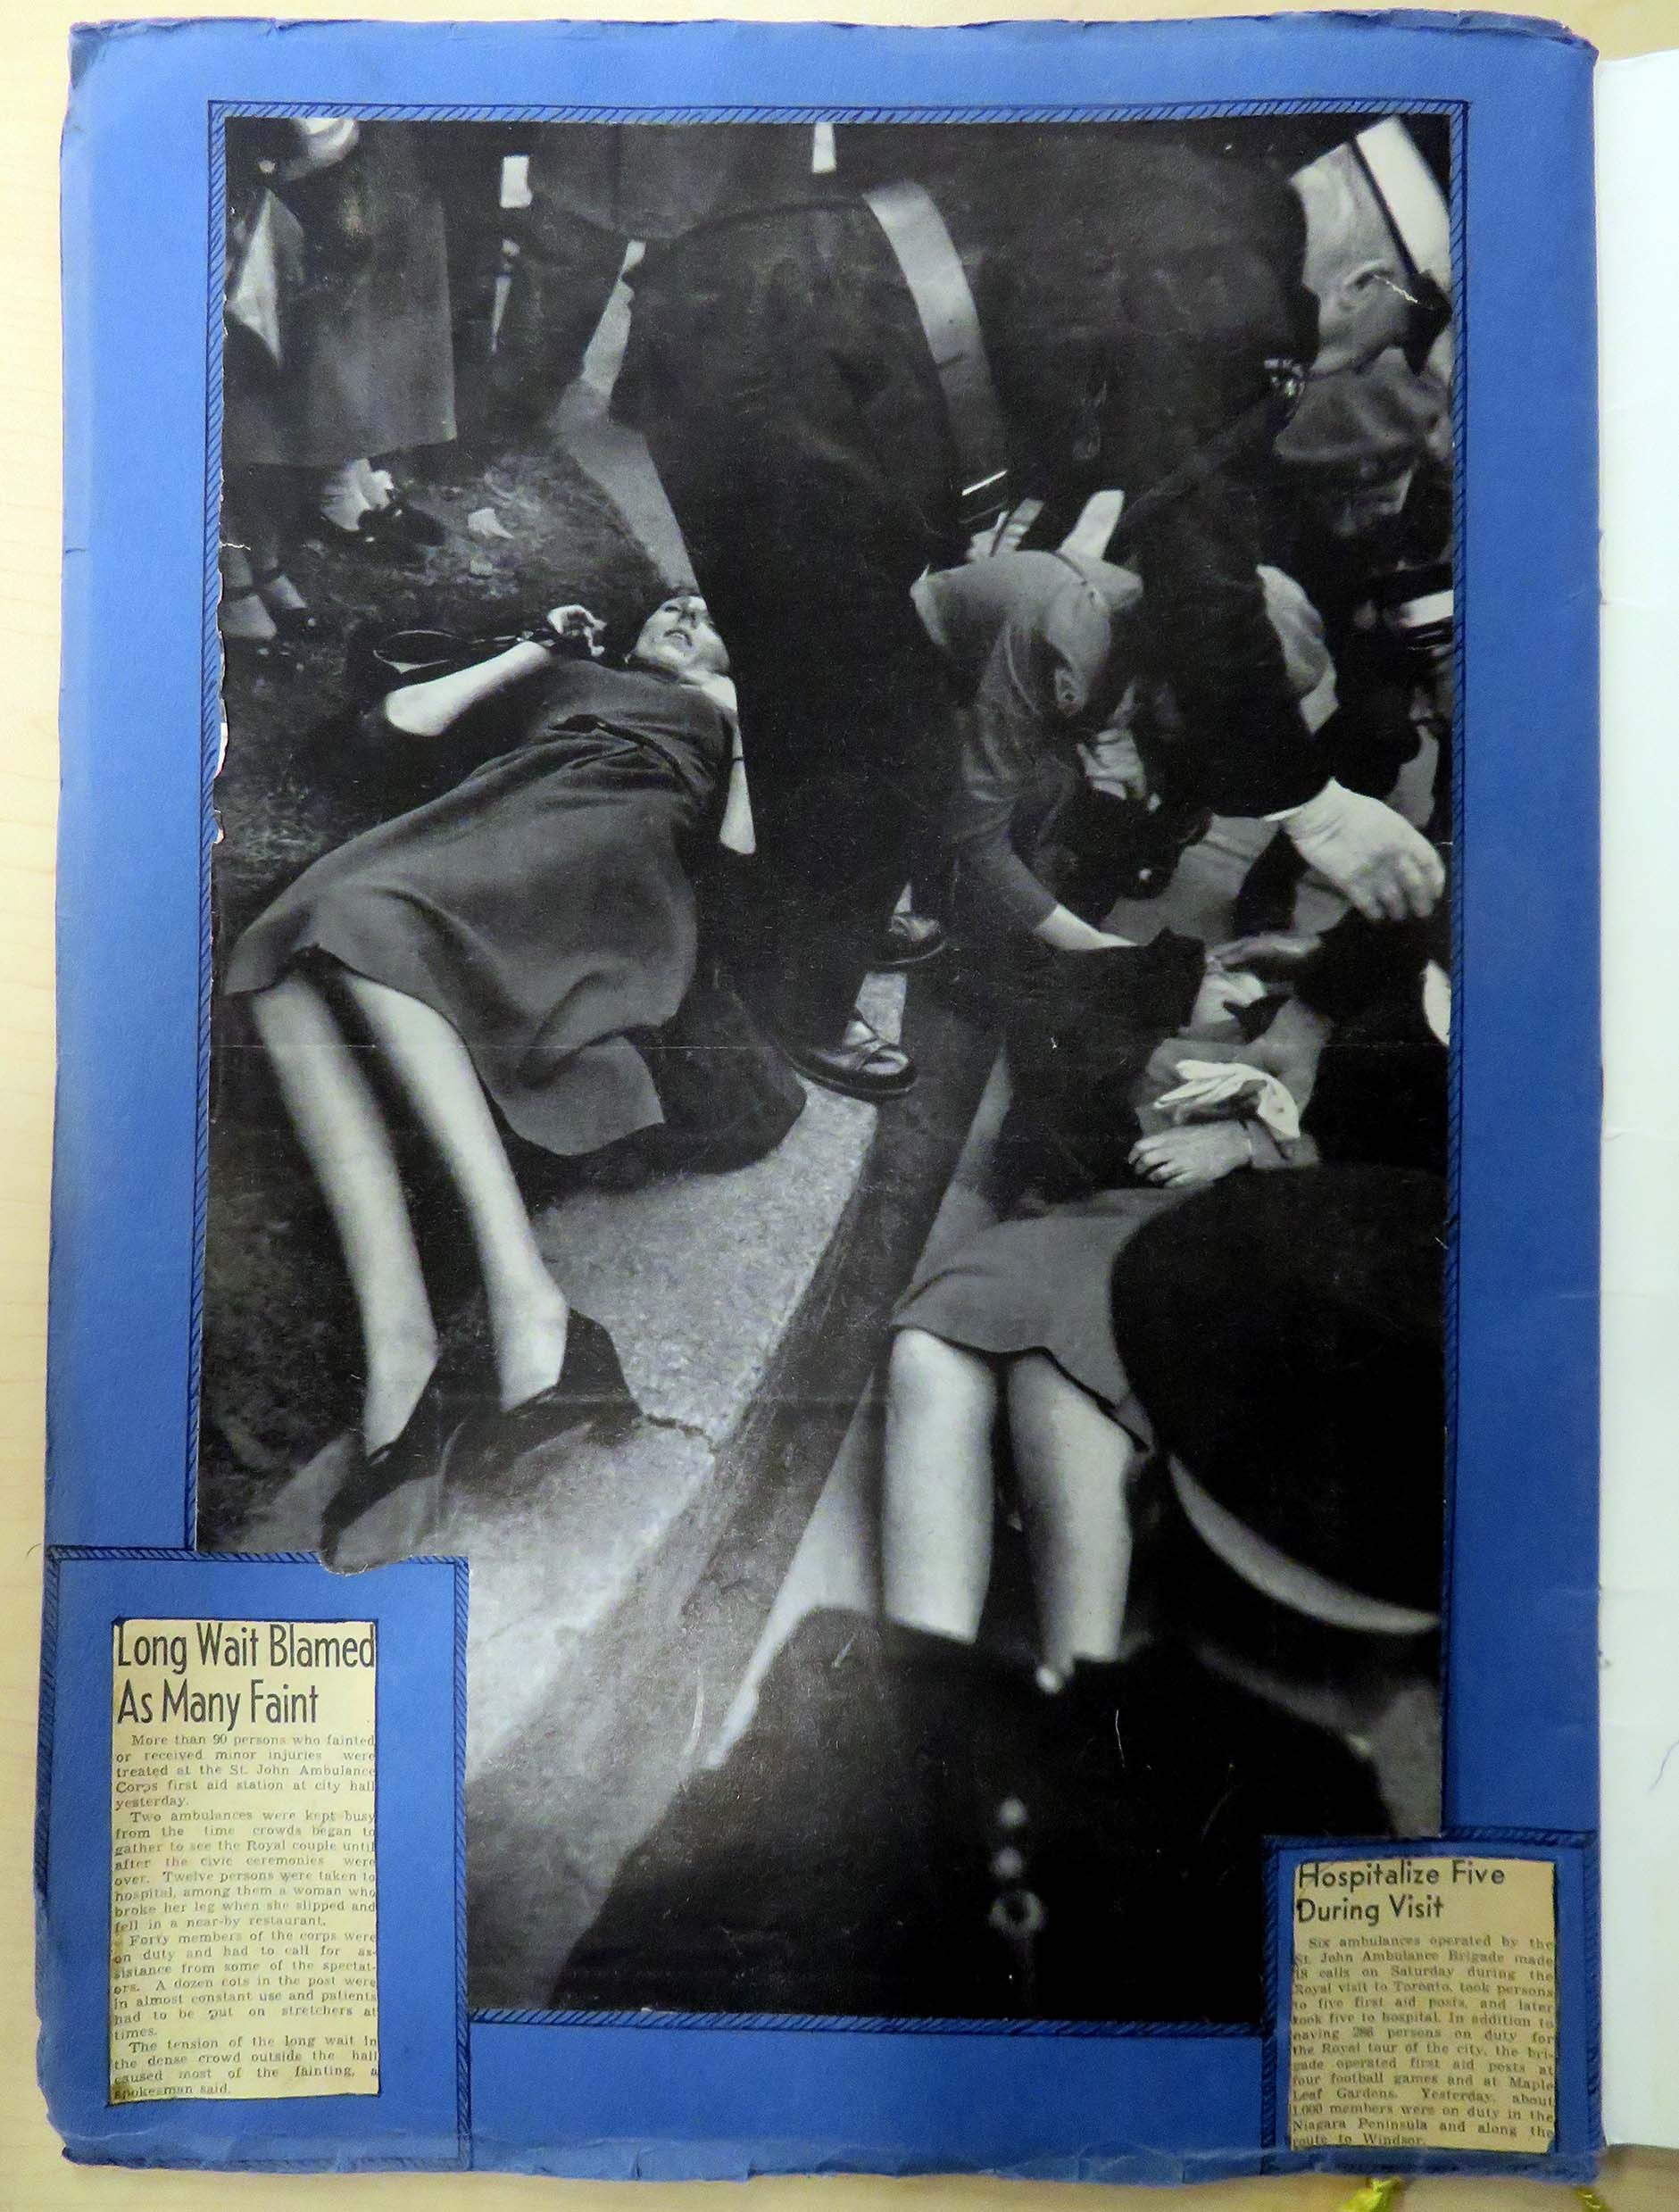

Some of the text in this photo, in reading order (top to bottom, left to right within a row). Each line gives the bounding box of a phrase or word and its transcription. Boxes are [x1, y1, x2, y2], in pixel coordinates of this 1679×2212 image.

[118, 1623, 374, 1675] Long Wait Blamed
[117, 1678, 319, 1731] As Many Faint
[175, 1734, 206, 1745] than
[213, 1734, 227, 1745] 90
[293, 1735, 320, 1746] who
[215, 1750, 256, 1759] minor
[200, 1766, 220, 1775] the
[257, 1765, 288, 1775] John
[168, 1780, 197, 1790] first
[207, 1780, 227, 1790] aid
[237, 1780, 284, 1790] station
[293, 1781, 307, 1790] at
[315, 1781, 340, 1793] city
[262, 1811, 295, 1821] were
[306, 1811, 335, 1823] kept
[162, 1826, 183, 1836] the
[312, 1826, 351, 1838] began
[219, 1841, 240, 1850] the
[247, 1841, 286, 1852] Royal
[293, 1841, 336, 1852] couple
[166, 1858, 187, 1867] the
[200, 1856, 233, 1866] civic
[163, 1872, 355, 1883] Twelve persons were taken
[1299, 1859, 1505, 1892] Hospitalize Five
[183, 1886, 342, 1899] among them woman
[164, 1903, 186, 1913] her
[195, 1901, 213, 1913] leg
[222, 1900, 259, 1911] when
[1298, 1895, 1444, 1926] During Visit
[149, 1919, 161, 1928] in
[187, 1917, 240, 1929] near-by
[250, 1932, 263, 1942] of
[271, 1931, 293, 1940] the
[300, 1933, 337, 1942] corps
[143, 1950, 174, 1961] duty
[187, 1947, 212, 1958] and
[224, 1946, 248, 1957] had
[262, 1946, 274, 1956] to
[285, 1945, 309, 1956] call
[320, 1945, 340, 1955] for
[181, 1961, 313, 1974] from some of the
[155, 1975, 336, 1991] A dozen in the post
[137, 1995, 183, 2006] almost
[259, 1992, 281, 2001] use
[289, 1991, 312, 2000] and
[154, 2011, 167, 2020] to
[179, 2008, 193, 2019] be
[167, 2039, 218, 2050] tension
[229, 2037, 243, 2047] of
[253, 2037, 274, 2046] the
[286, 2036, 315, 2047] long
[325, 2036, 353, 2045] wait
[147, 2055, 187, 2066] dense
[198, 2052, 240, 2064] crowd
[252, 2051, 301, 2061] outside
[312, 2051, 335, 2060] the
[229, 2068, 241, 2078] of
[257, 2067, 278, 2077] the
